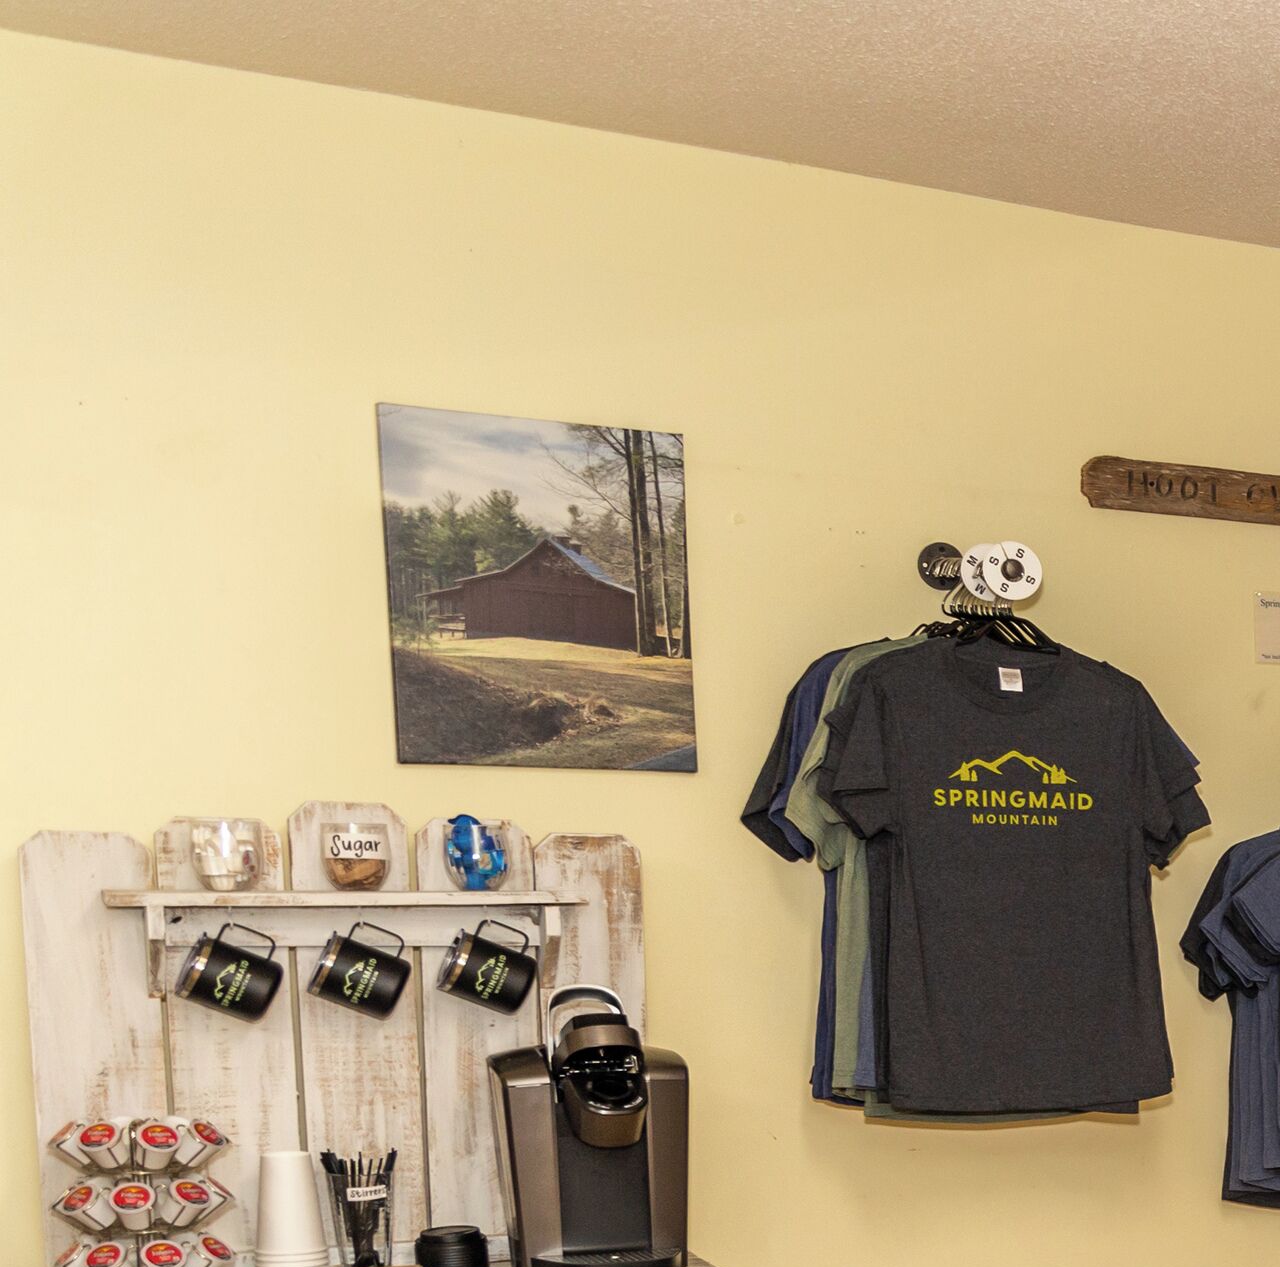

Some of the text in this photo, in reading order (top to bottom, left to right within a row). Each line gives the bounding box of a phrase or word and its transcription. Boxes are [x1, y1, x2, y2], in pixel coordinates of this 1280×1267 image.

[1127, 469, 1218, 505] HOOT
[1015, 548, 1025, 559] S
[933, 788, 1094, 811] SPRINGMAID
[972, 813, 1058, 826] MOUNTAIN
[330, 834, 381, 859] Sugar
[220, 959, 250, 1007] SPRINGMAID
[350, 957, 378, 1005] SPRINGMAID
[481, 953, 508, 1000] SPRINGMAID
[350, 1187, 386, 1198] Stirrers
